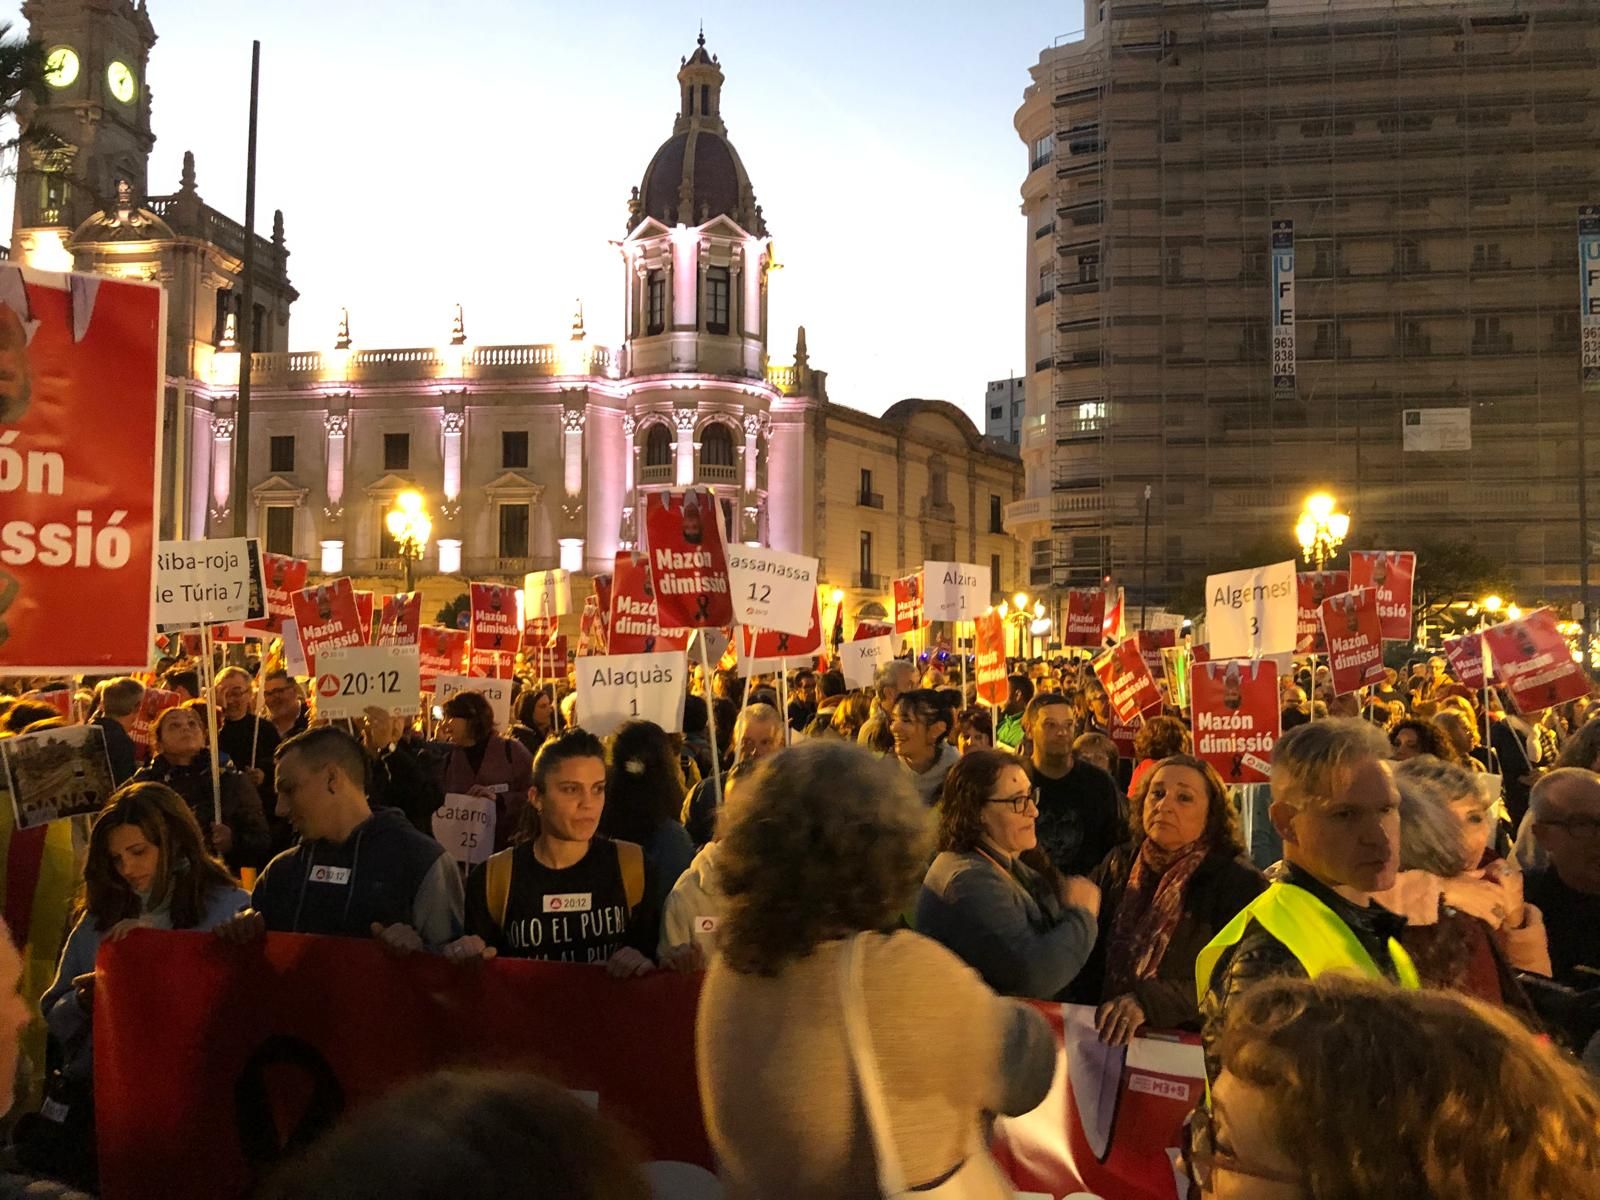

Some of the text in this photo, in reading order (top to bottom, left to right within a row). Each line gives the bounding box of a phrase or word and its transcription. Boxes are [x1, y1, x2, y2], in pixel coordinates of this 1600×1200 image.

[1274, 338, 1293, 349] 963
[1274, 350, 1293, 361] 838
[1274, 363, 1294, 375] 045
[1, 510, 131, 569] ssió
[655, 545, 711, 570] Mazón
[728, 554, 810, 581] assanassa
[659, 571, 727, 594] dimissió
[943, 571, 976, 587] Alzira
[180, 583, 227, 602] Túria
[233, 581, 243, 599] 7
[747, 582, 771, 603] 12
[1213, 574, 1291, 608] Algemesí
[960, 596, 965, 609] 1
[475, 610, 507, 623] Mazón
[1250, 617, 1259, 636] 3
[302, 619, 343, 640] Mazón
[476, 622, 517, 636] dimissió
[307, 630, 359, 655] dimissió
[1332, 632, 1368, 653] Mazón
[471, 655, 511, 667] dimiió
[1335, 644, 1379, 670] dimissió
[342, 671, 401, 696] 20:12
[592, 664, 672, 688] Alaquàs
[629, 699, 640, 716] 1
[1198, 711, 1253, 731] Mazón
[1199, 732, 1273, 753] dimissió
[460, 832, 478, 848] 25
[564, 898, 586, 908] 20:12
[510, 917, 543, 948] OLO
[551, 916, 573, 943] EL
